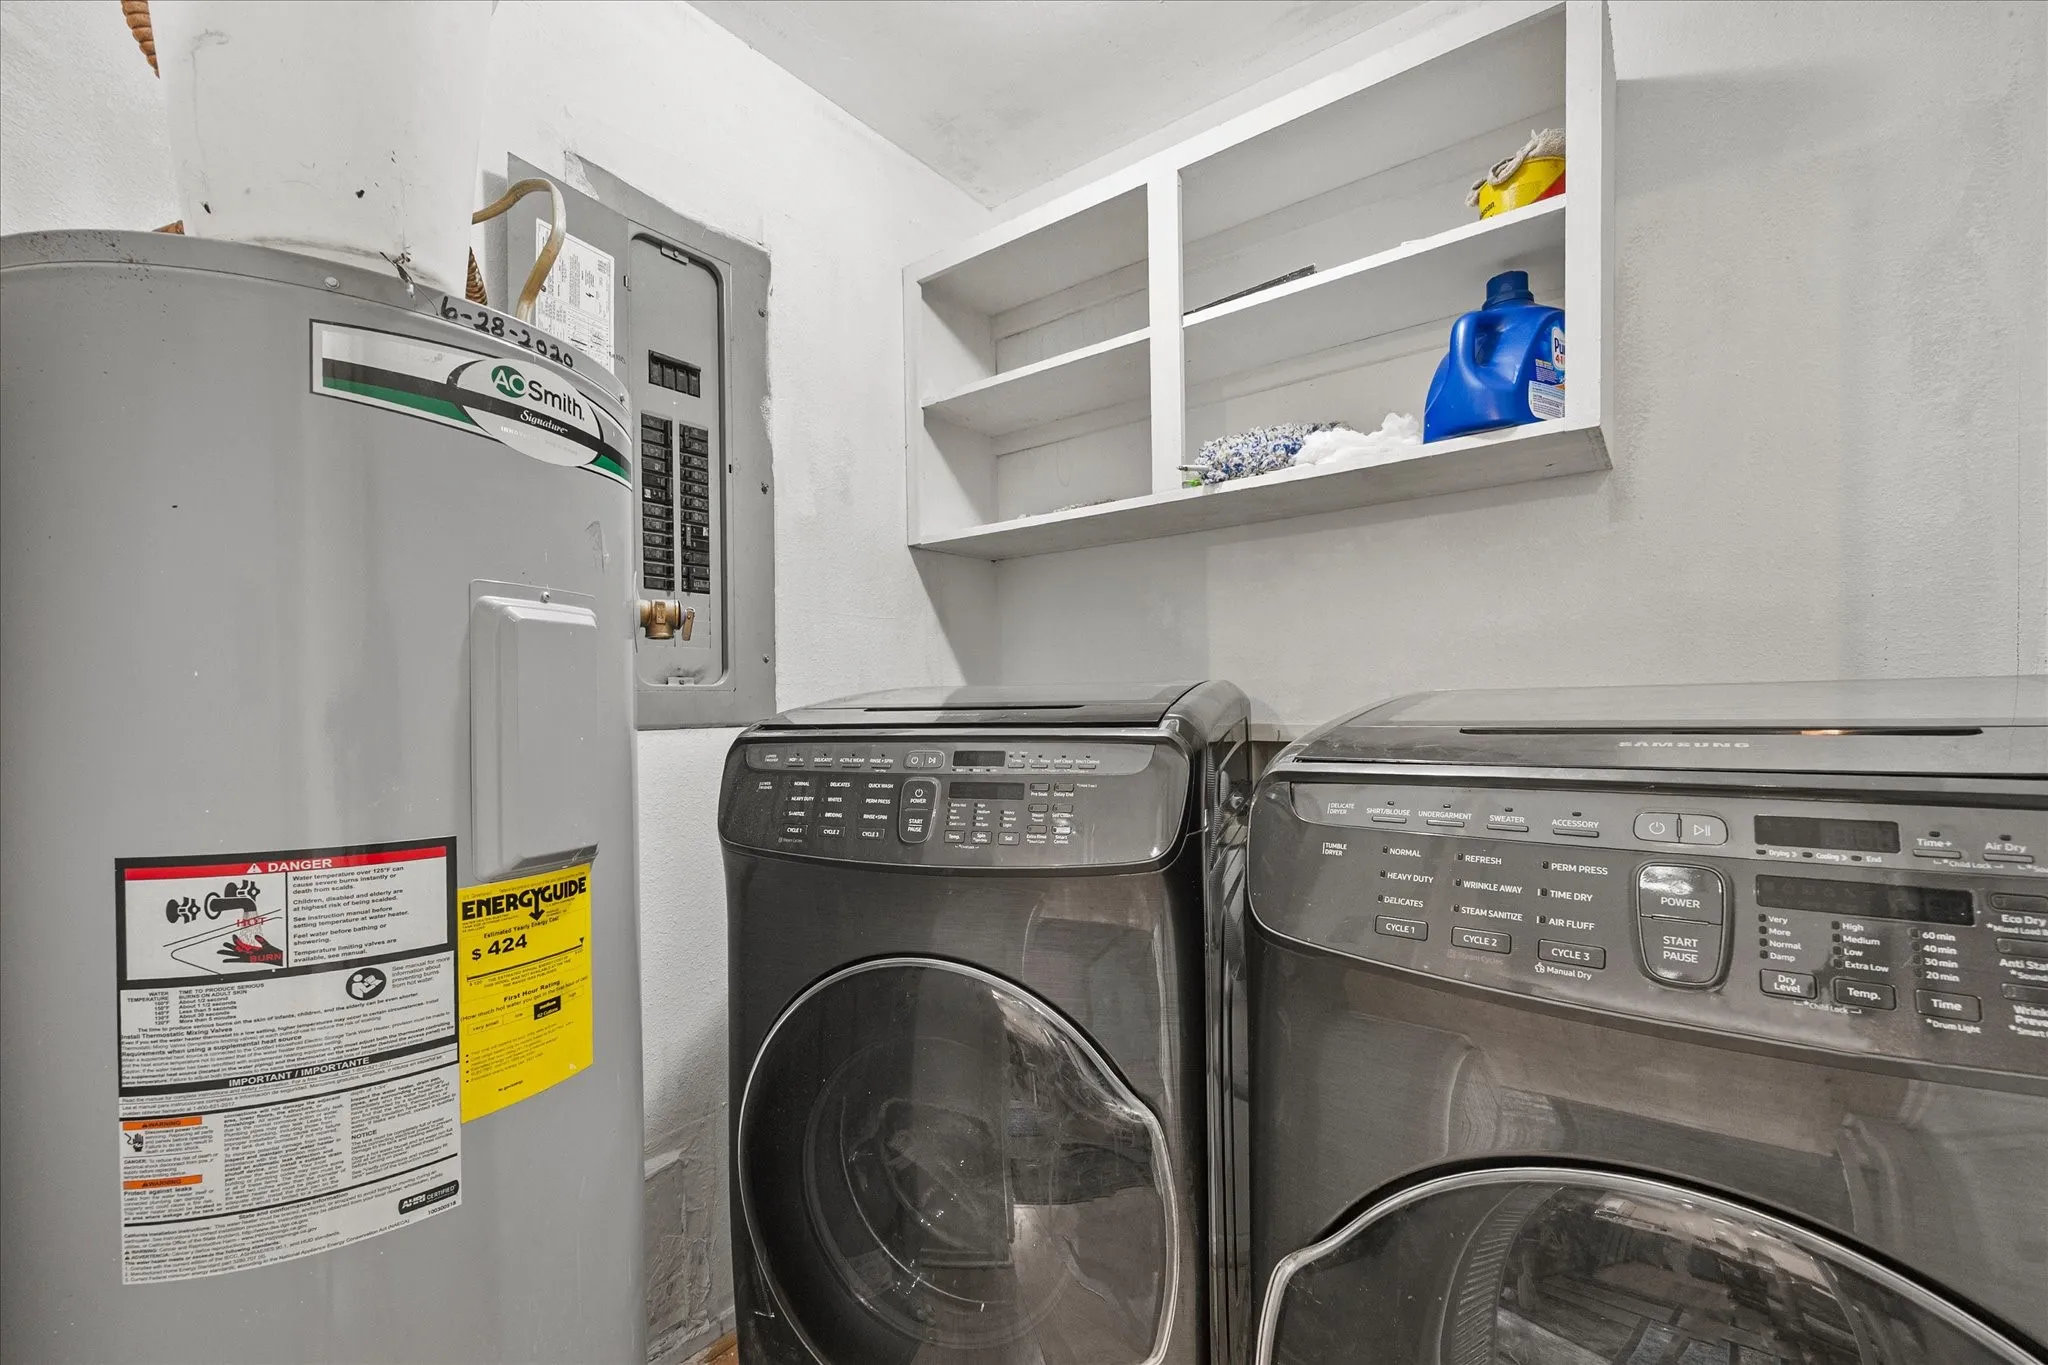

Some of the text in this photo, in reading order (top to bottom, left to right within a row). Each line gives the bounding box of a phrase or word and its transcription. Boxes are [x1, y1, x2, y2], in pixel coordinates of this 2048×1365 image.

[440, 295, 573, 368] 6-28-2020
[1554, 337, 1566, 356] Pu
[520, 409, 564, 434] Signature
[1366, 808, 1411, 816] SHIRT/BLOUSE
[1418, 810, 1472, 821] UNDERGARMENT
[1490, 814, 1525, 823] SWEATER
[1552, 819, 1599, 829] ACCESSORY
[1325, 842, 1347, 850] TUMBLE
[1917, 838, 1952, 848] Time+
[1985, 842, 2027, 854] Air Dry
[1389, 848, 1421, 857] NORMAL
[1769, 849, 1790, 858] Drying
[1816, 853, 1839, 862] Cooling
[268, 858, 333, 873] DANGER
[1465, 855, 1502, 865] REFRESH
[1551, 863, 1608, 875] PERM PRESS
[314, 871, 355, 879] temperature
[1387, 872, 1434, 884] HEAVY DUTY
[1463, 881, 1523, 894] WRINKLE AWAY
[326, 893, 354, 901] disabled
[462, 876, 586, 921] ENERGYGUIDE
[1550, 889, 1593, 902] TIME DRY
[1384, 896, 1424, 908] DELICATES
[1661, 897, 1700, 908] POWER
[308, 912, 345, 921] instruction
[1461, 907, 1523, 921] STEAM SANITIZE
[318, 917, 359, 926] temperature
[1549, 918, 1595, 930] AIR FLUFF
[1768, 915, 1788, 925] Very
[2001, 914, 2046, 927] Eco Dry
[353, 923, 378, 932] bathing
[484, 928, 512, 939] Estimated
[514, 924, 530, 932] Yearly
[531, 920, 548, 928] Energy
[1386, 922, 1415, 934] CYCLE 1
[1768, 928, 1791, 936] More
[1842, 923, 1864, 932] High
[294, 937, 331, 946] showering.
[1463, 934, 1497, 946] CYCLE 2
[1663, 935, 1698, 947] START
[1842, 935, 1881, 946] Medium
[1937, 933, 1956, 941] min
[294, 946, 336, 956] Temperature
[338, 943, 362, 951] limiting
[472, 934, 527, 961] $ 424
[1769, 940, 1802, 950] Normal
[1923, 945, 1957, 955] 40 min
[249, 952, 282, 963] BURN
[1551, 948, 1590, 961] CYCLE 3
[1663, 951, 1698, 963] PAUSE
[1770, 952, 1795, 962] Damp
[1844, 948, 1863, 957] Low
[1845, 961, 1889, 973] Extra Low
[1925, 957, 1958, 968] 30 min
[2000, 958, 2024, 969] Anti
[1547, 966, 1592, 981] Manual Dry
[1926, 971, 1960, 982] 20 min
[1778, 974, 1796, 985] Dry
[504, 980, 560, 1002] First Hour Rating
[1774, 982, 1801, 993] Level
[1847, 987, 1881, 1001] Temp.
[1931, 998, 1963, 1011] Time
[1933, 1020, 1981, 1033] Drum Light
[228, 1071, 292, 1087] IMPORTANT
[301, 1056, 369, 1076] IMPORTANTE
[352, 1130, 377, 1140] NOTICE
[427, 1185, 454, 1200] CERTIFIED
